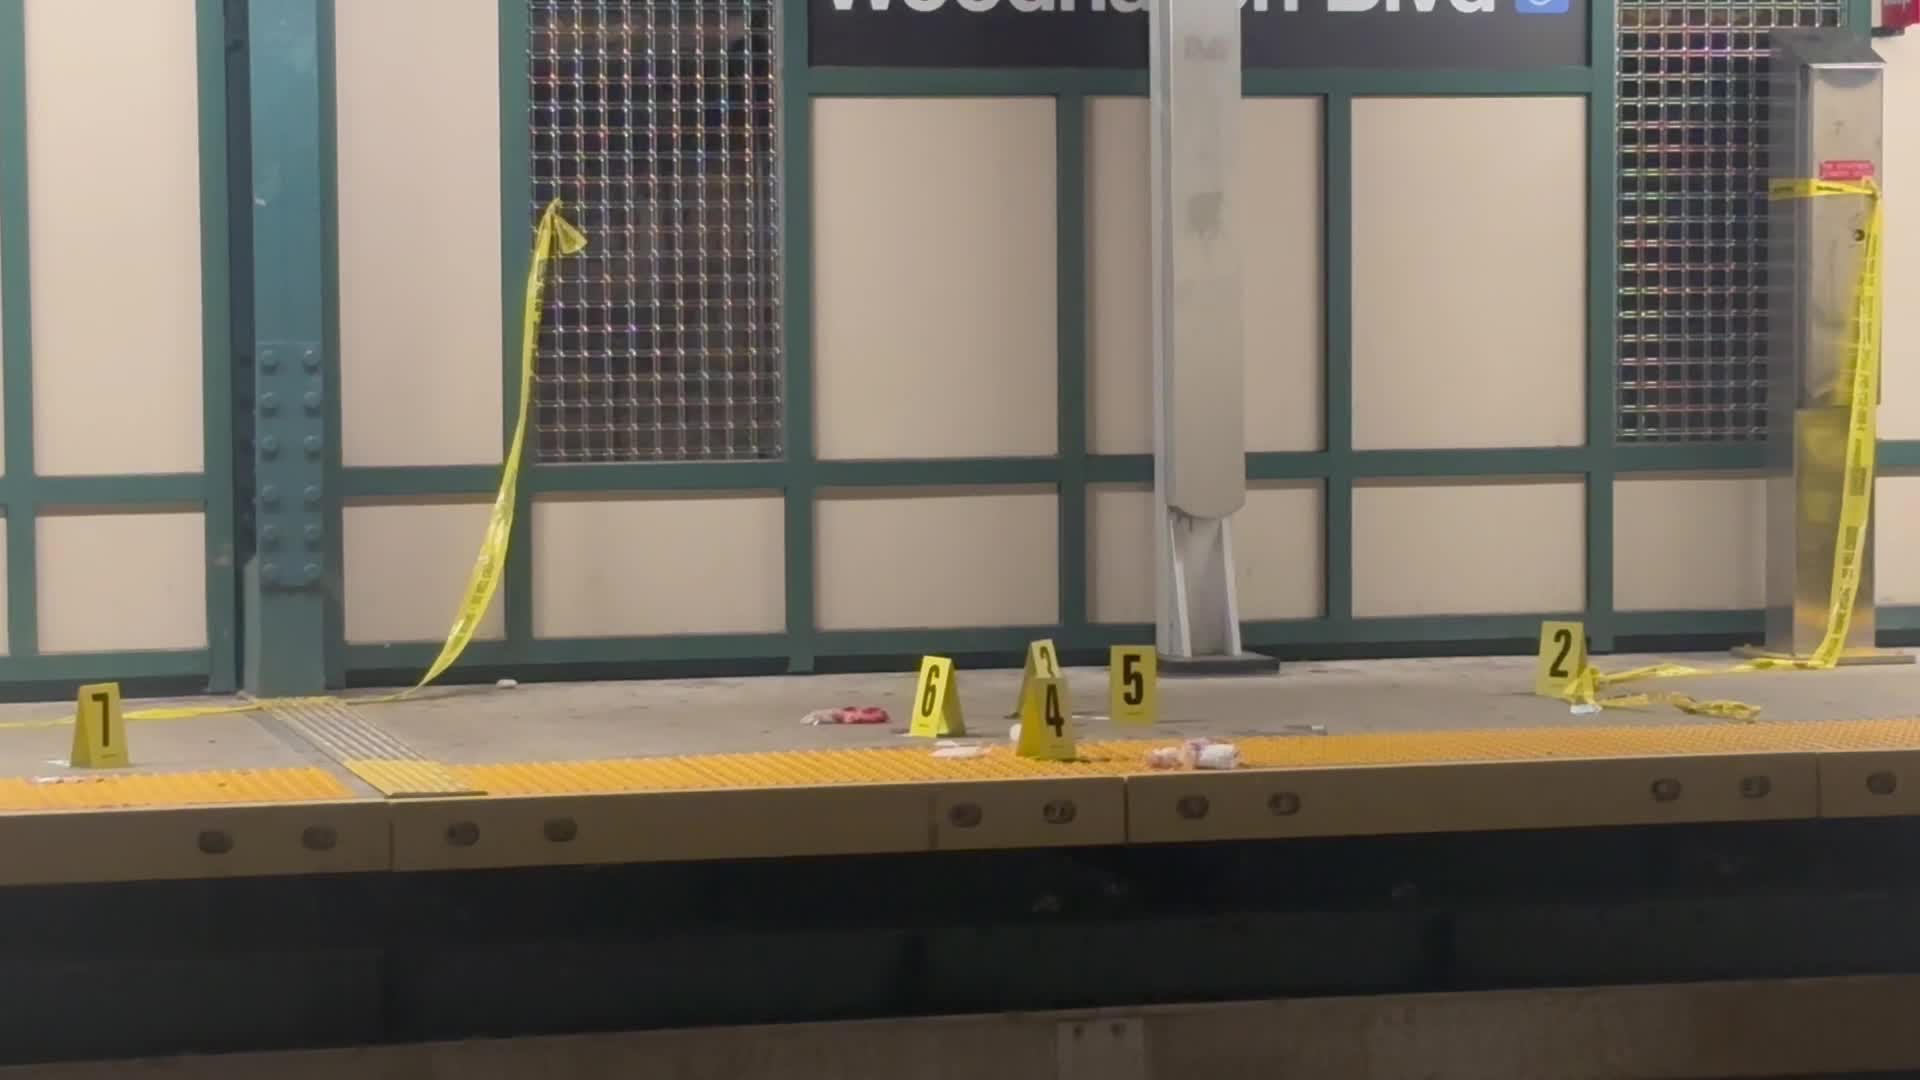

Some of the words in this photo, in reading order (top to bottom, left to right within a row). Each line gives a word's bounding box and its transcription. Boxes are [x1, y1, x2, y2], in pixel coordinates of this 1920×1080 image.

[1122, 654, 1144, 705] 5
[1549, 629, 1572, 678] 2
[921, 664, 940, 717] 6
[1045, 684, 1065, 737] 4
